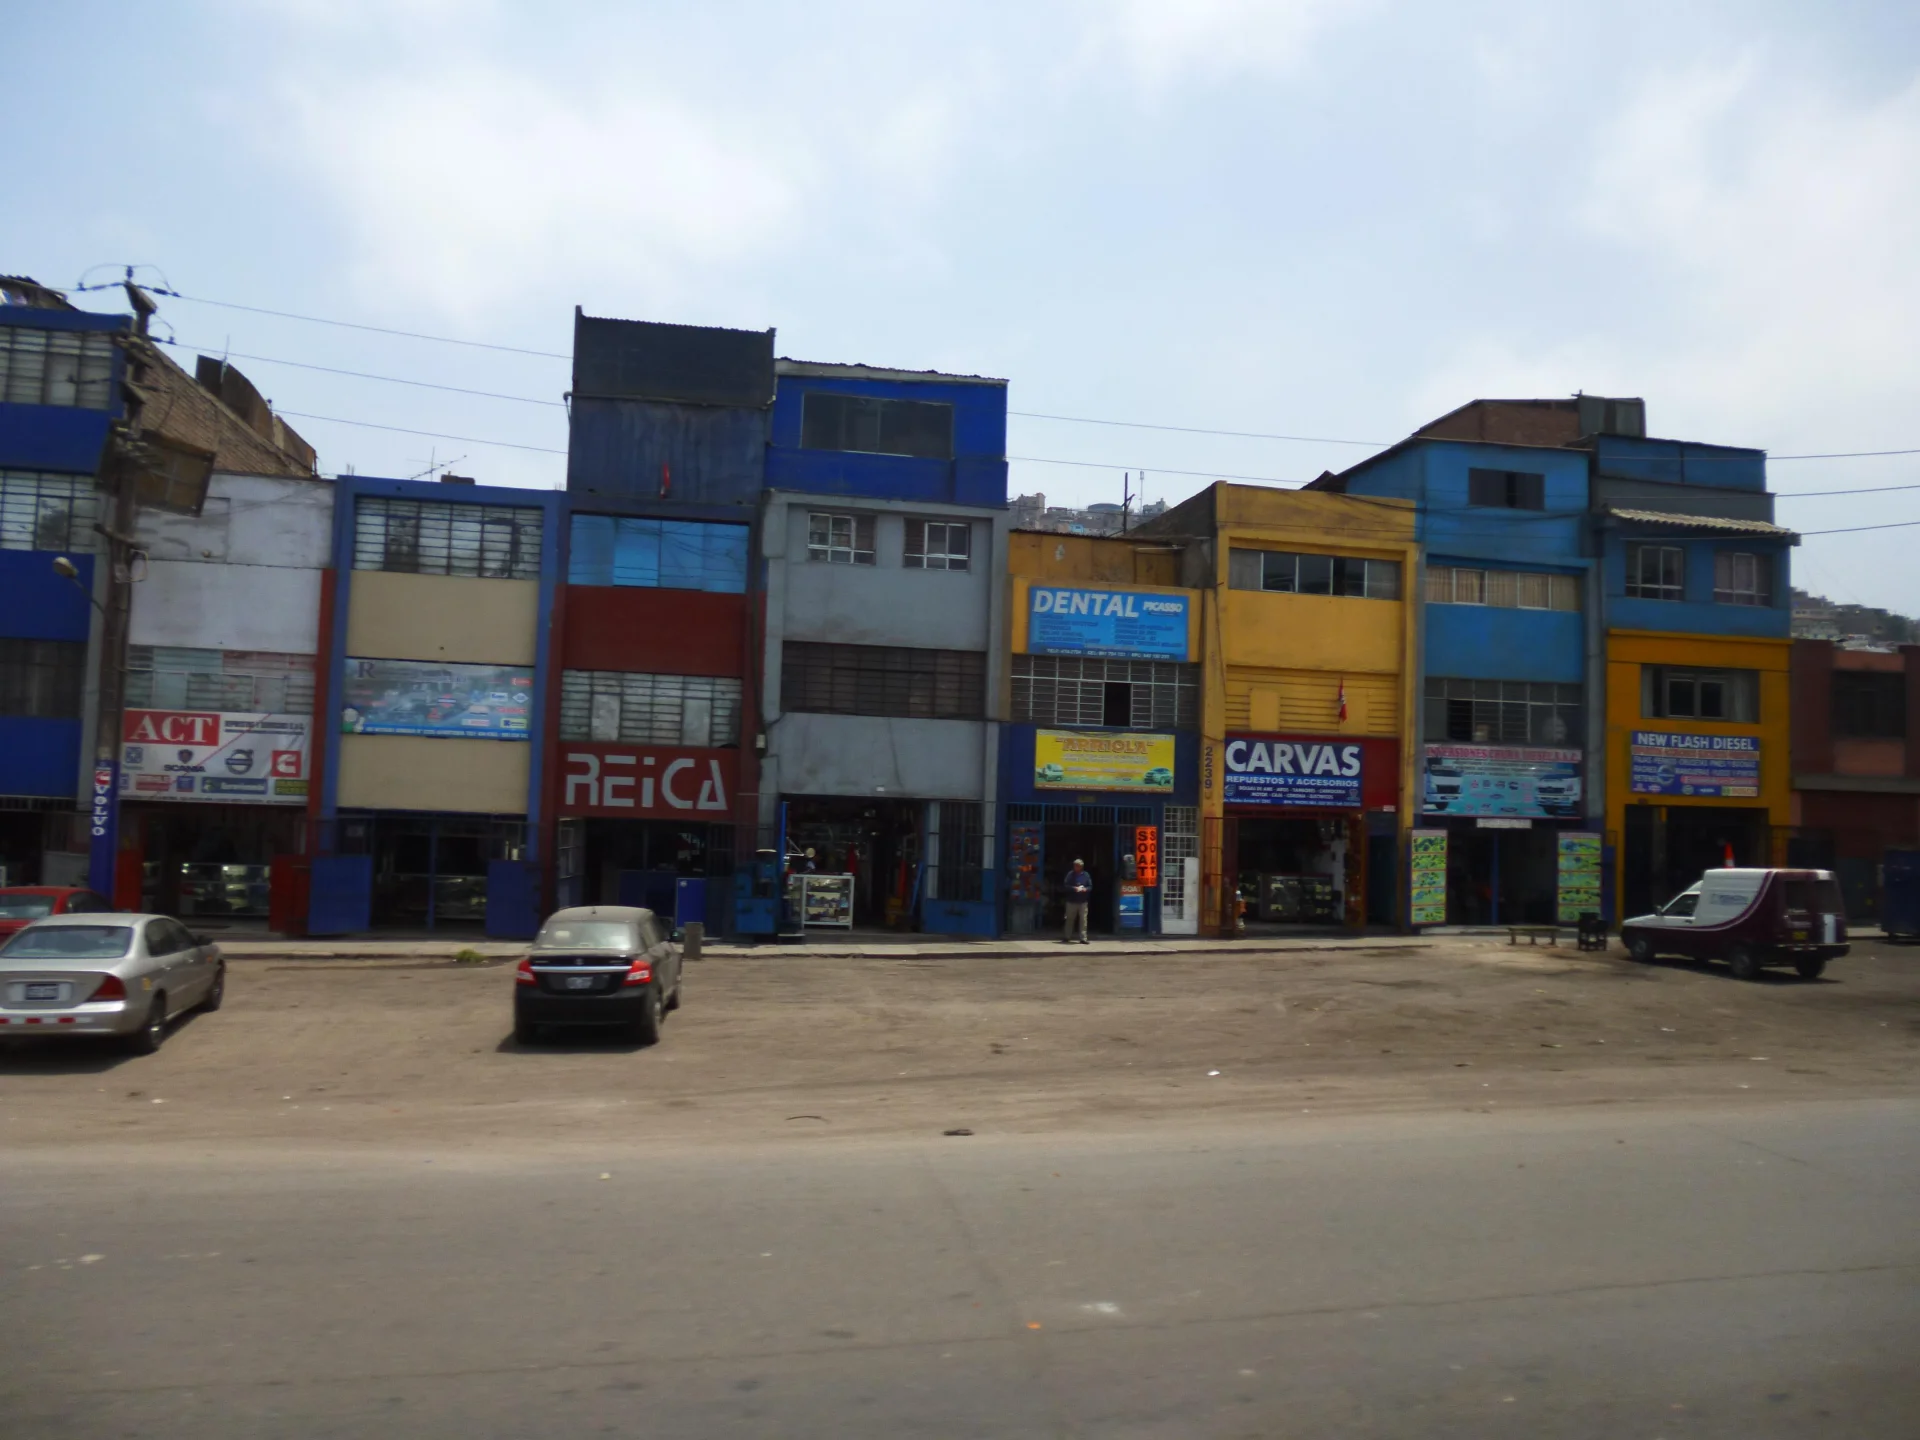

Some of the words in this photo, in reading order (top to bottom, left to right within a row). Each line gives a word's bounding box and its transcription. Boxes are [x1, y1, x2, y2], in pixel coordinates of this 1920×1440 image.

[1033, 590, 1139, 617] DENTAL
[1142, 601, 1184, 613] PICASSO
[357, 661, 376, 678] R
[128, 714, 213, 743] ACT
[1637, 732, 1668, 747] NEW
[1671, 735, 1710, 749] FLASH
[1713, 737, 1754, 750] DIESEL
[163, 764, 206, 772] SCANIA
[1225, 740, 1361, 776] CARVAS
[1226, 775, 1285, 785] REPUESTOS
[1288, 777, 1294, 785] Y
[1296, 777, 1359, 787] ACCESORIOS
[92, 785, 110, 836] VOLVO
[1137, 830, 1148, 877] SOAT
[1149, 830, 1157, 877] SOAT
